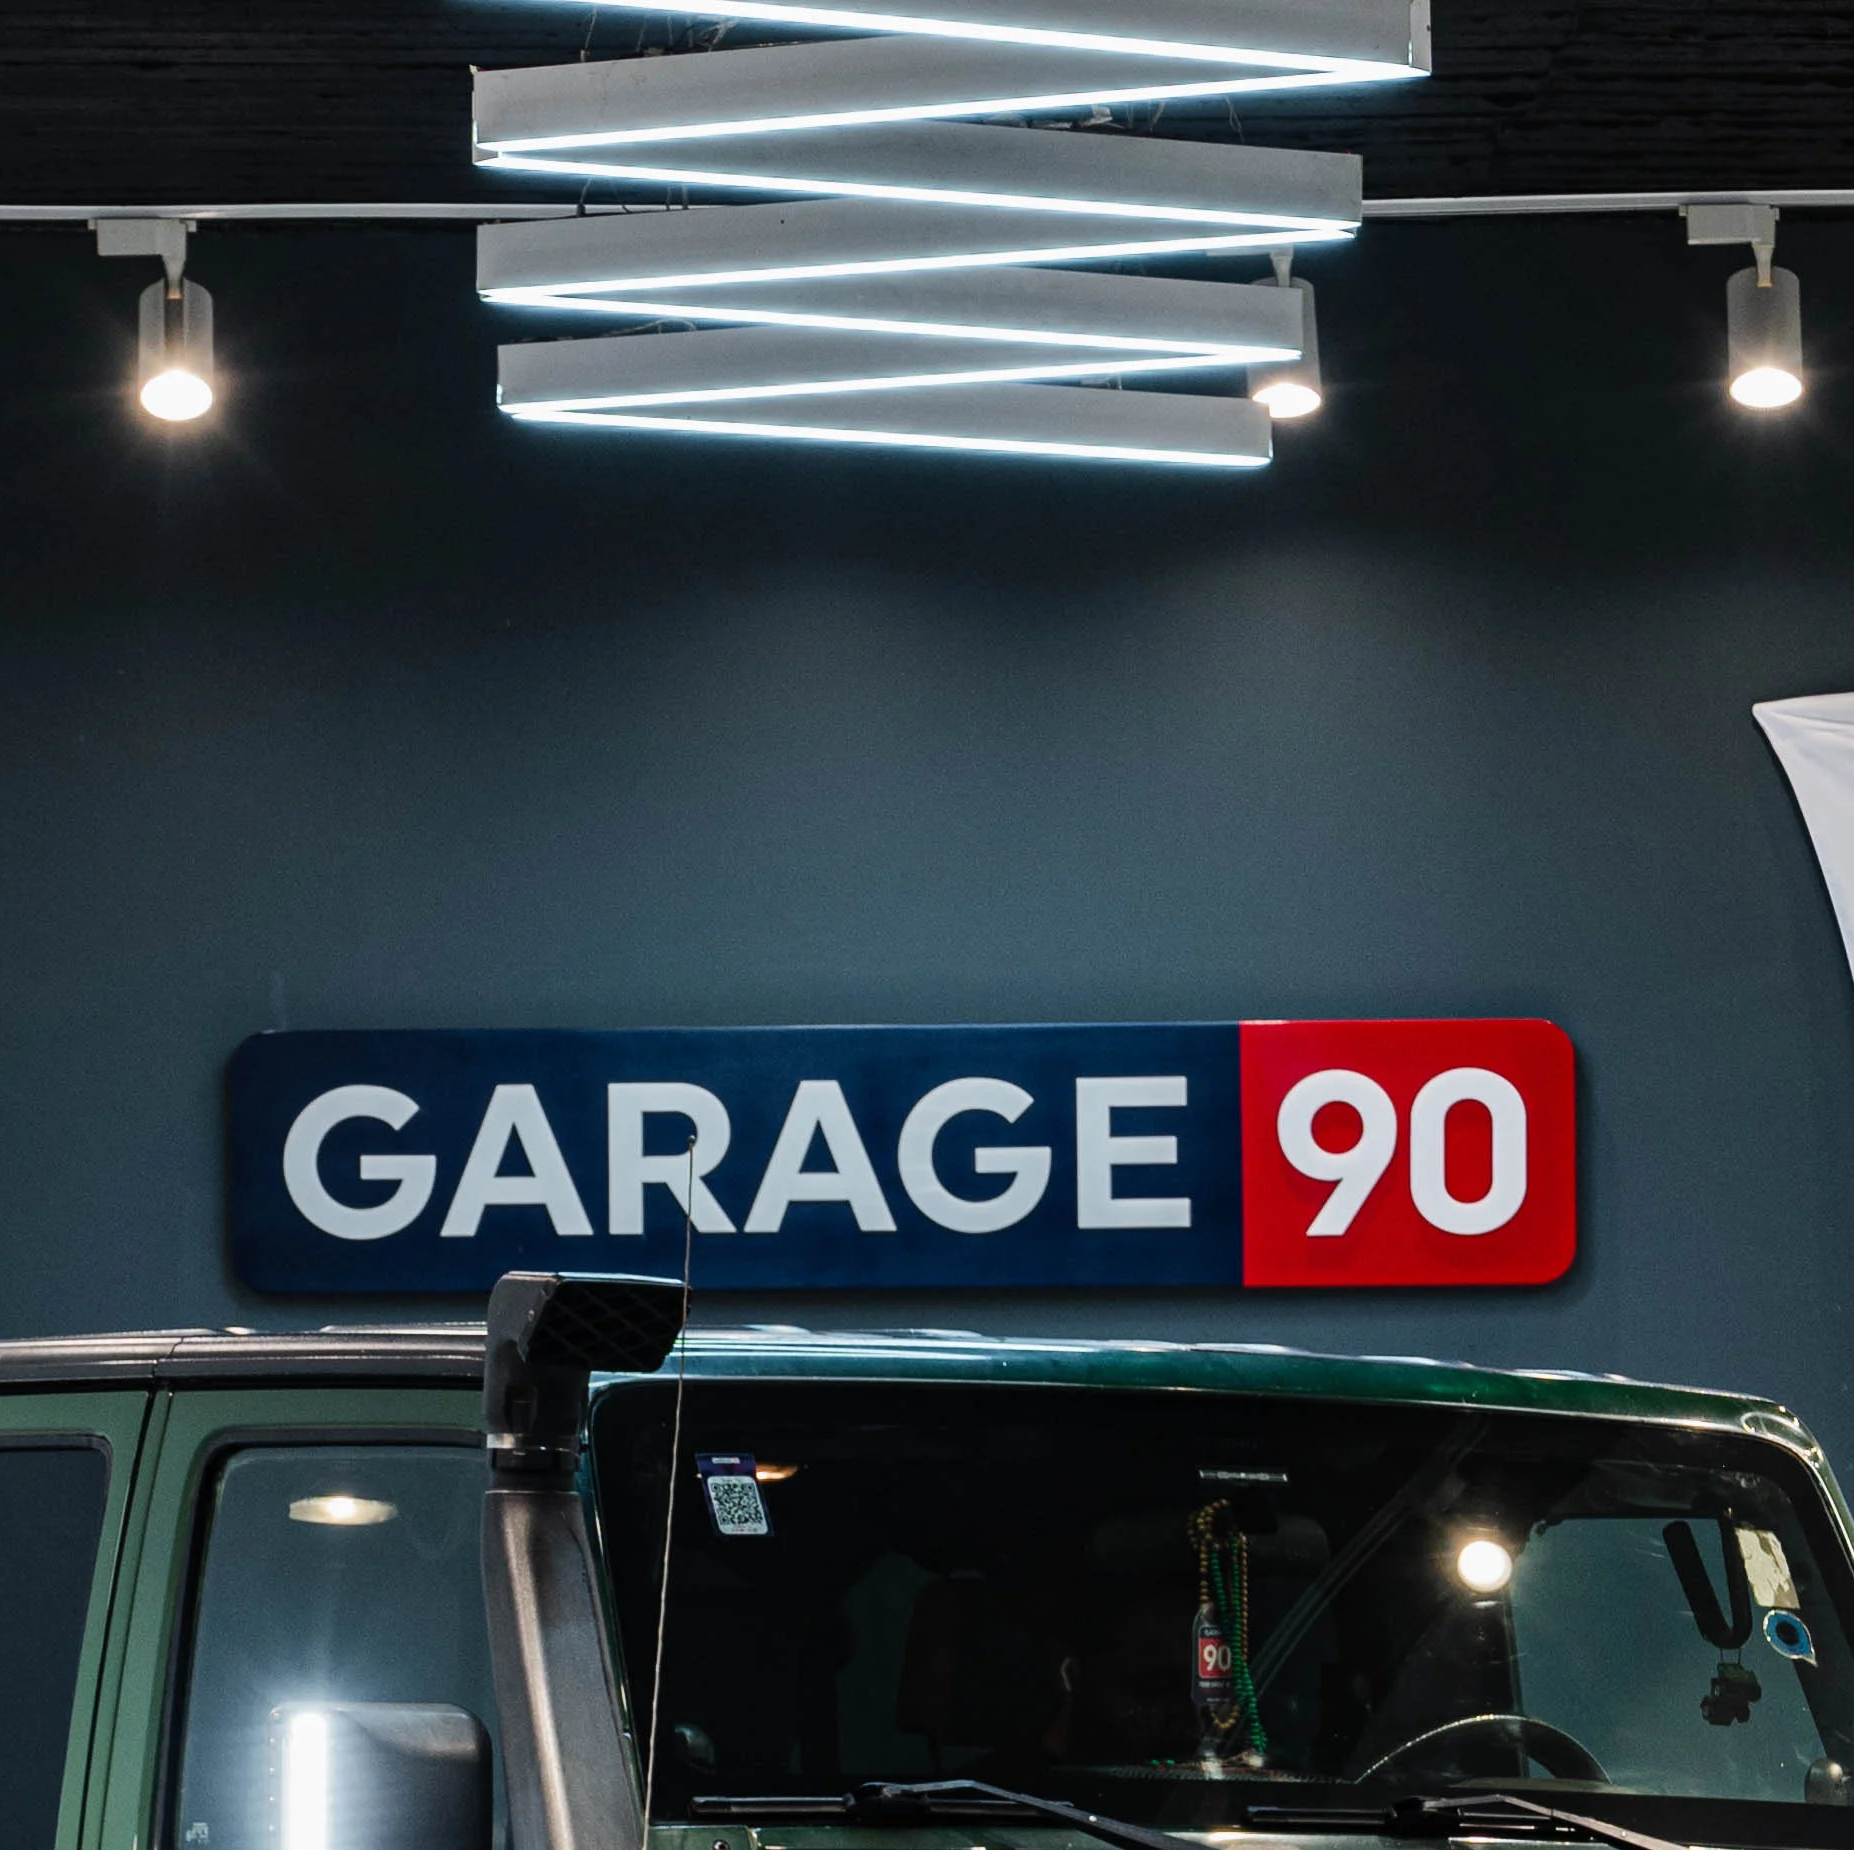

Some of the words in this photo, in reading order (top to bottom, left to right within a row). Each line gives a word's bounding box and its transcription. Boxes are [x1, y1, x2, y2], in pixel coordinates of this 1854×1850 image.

[282, 1075, 1193, 1241] GARAGE
[1275, 1066, 1528, 1238] 90
[1203, 1644, 1232, 1671] 90
